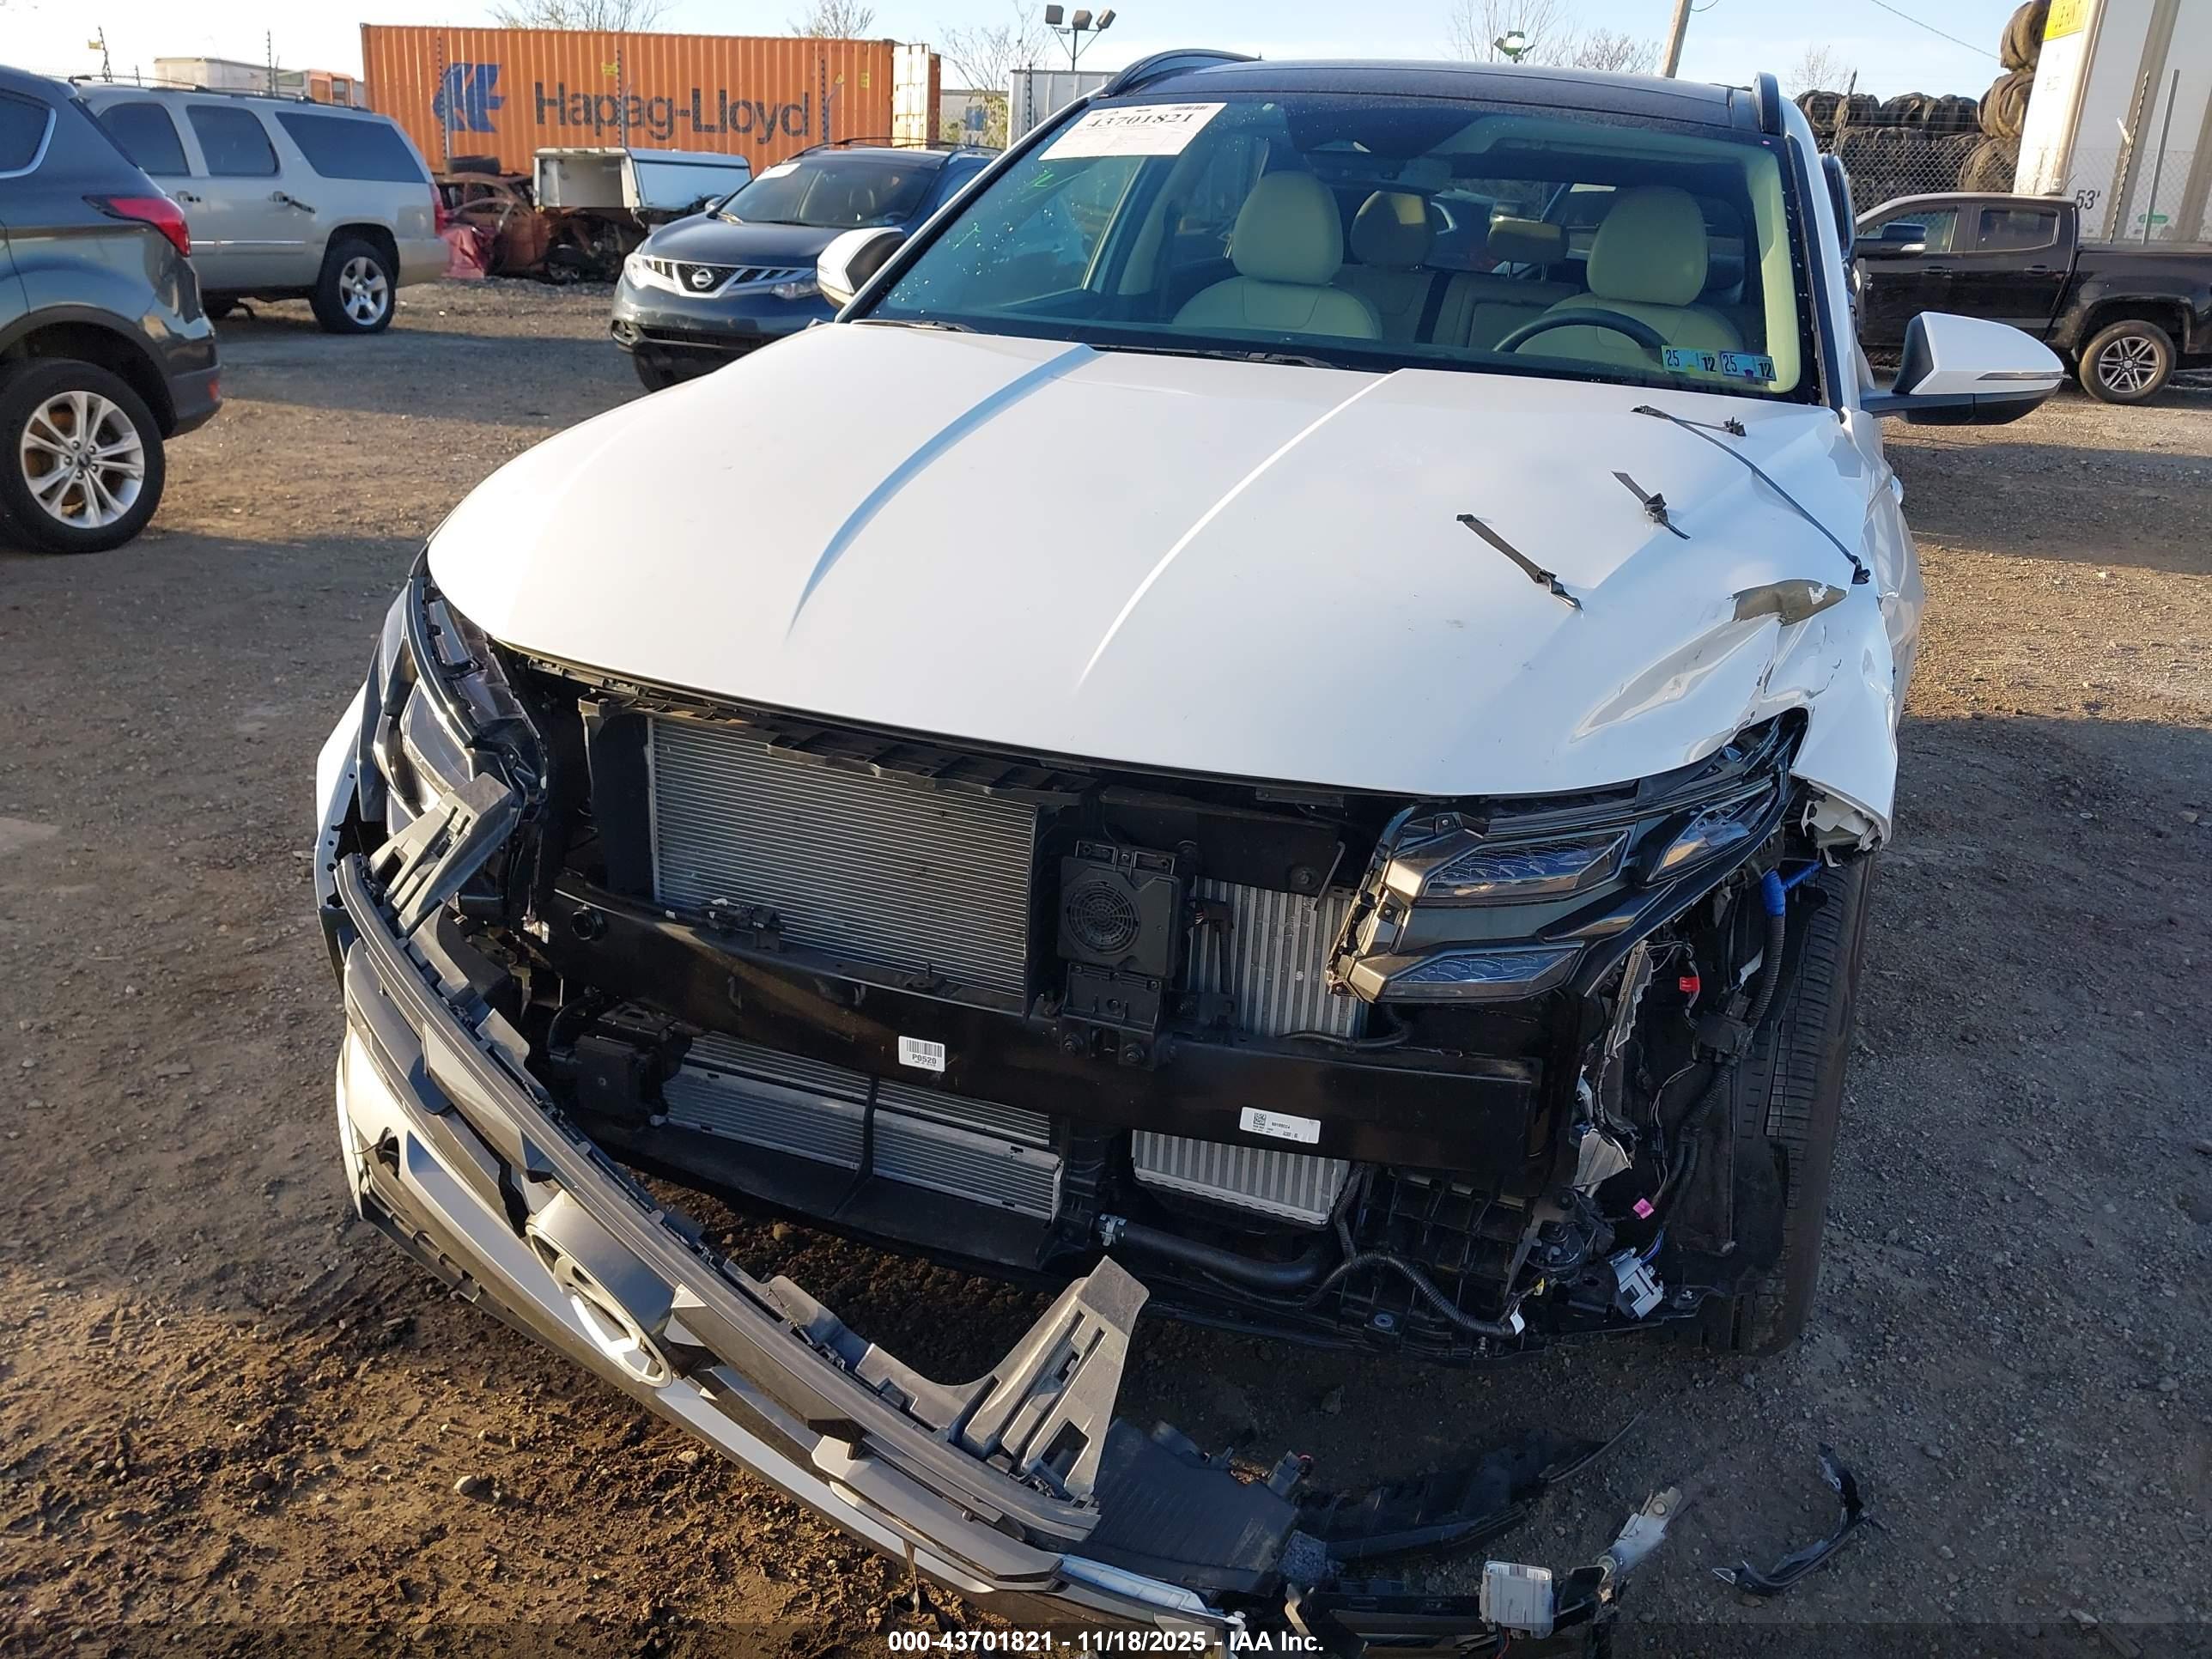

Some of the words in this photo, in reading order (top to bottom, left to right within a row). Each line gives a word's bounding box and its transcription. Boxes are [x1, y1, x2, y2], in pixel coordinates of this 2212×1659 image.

[534, 82, 810, 144] Hapag-Lloyd
[1085, 112, 1194, 128] 43701821
[2075, 189, 2102, 210] 53'
[1666, 349, 1680, 368] 25
[1701, 356, 1717, 373] 12
[1723, 355, 1738, 373] 25
[1758, 362, 1774, 378] 12
[912, 1054, 937, 1065] P0520
